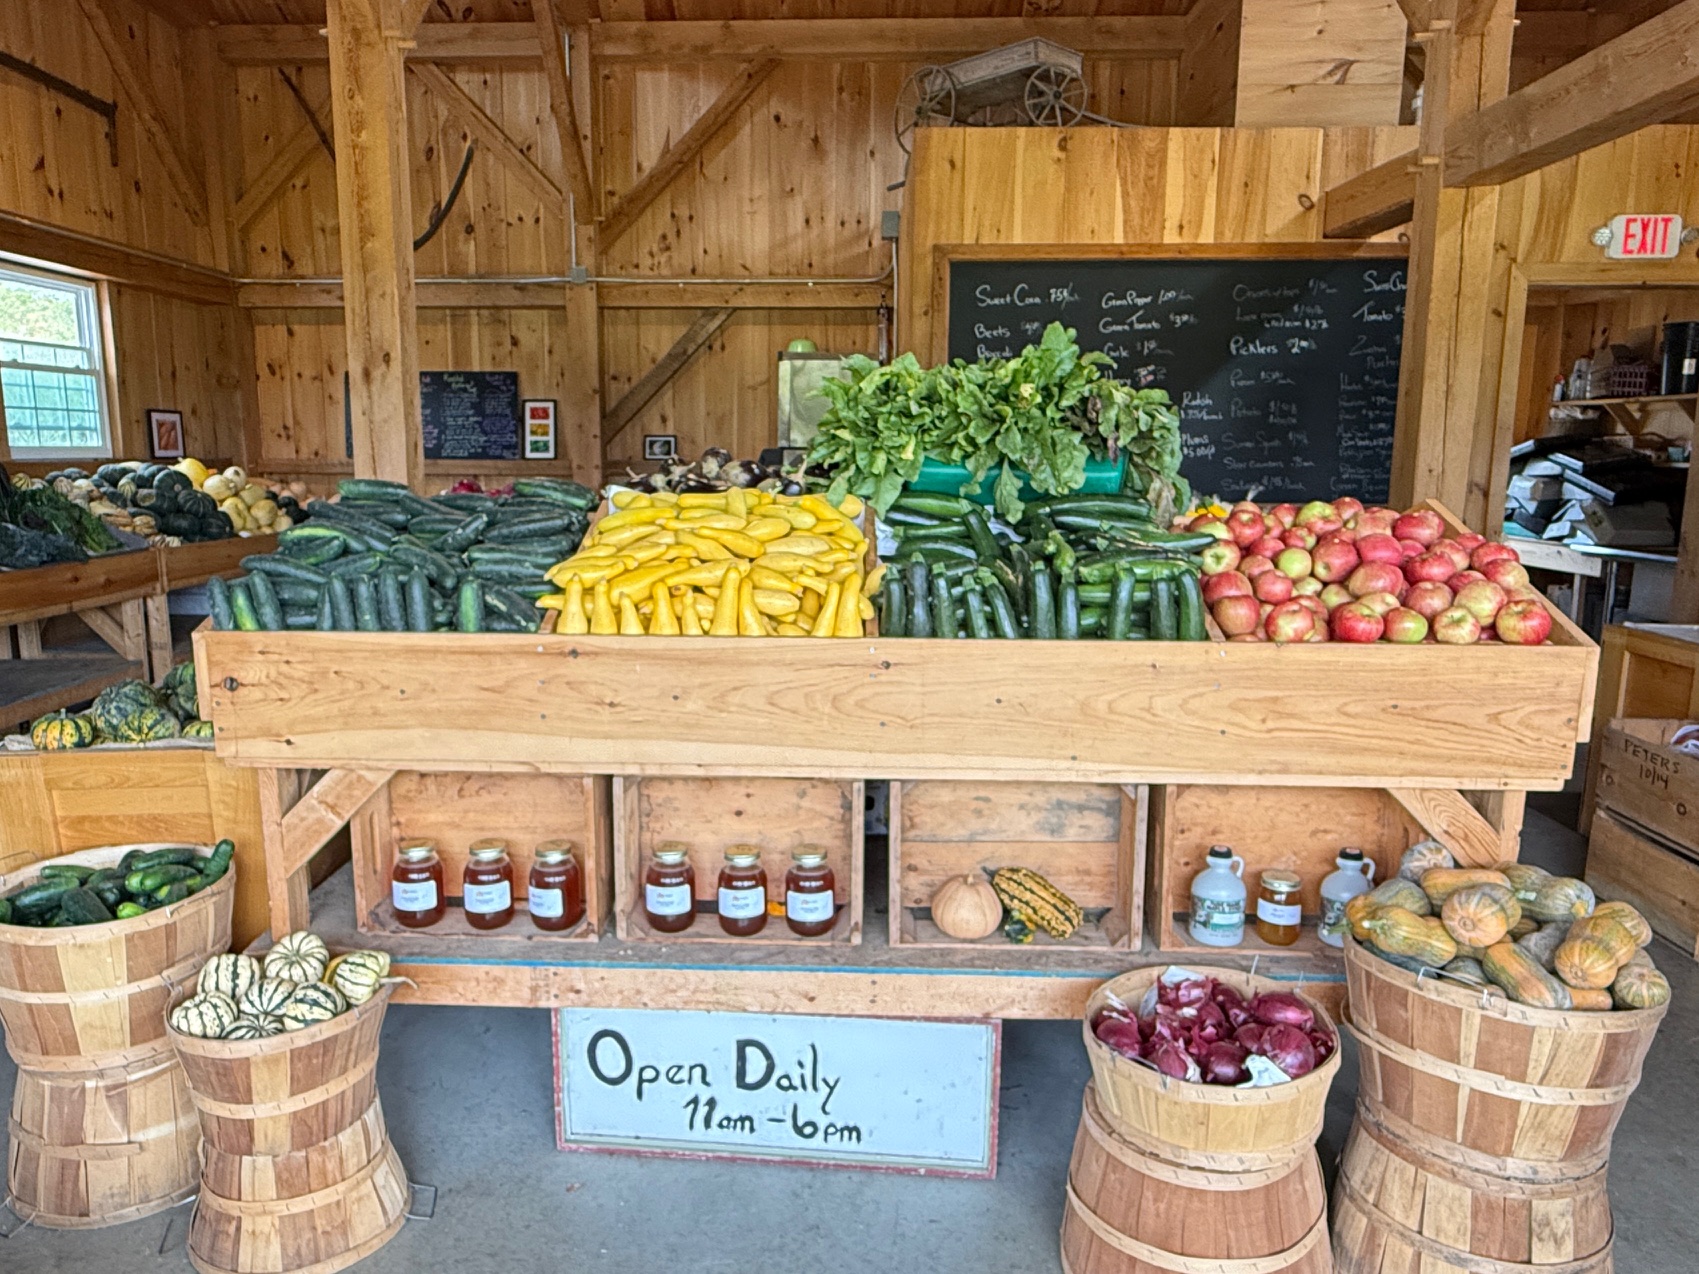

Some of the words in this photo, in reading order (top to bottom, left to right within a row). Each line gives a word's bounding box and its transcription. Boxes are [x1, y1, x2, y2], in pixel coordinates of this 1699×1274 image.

[1622, 216, 1674, 255] EXIT
[974, 323, 1011, 339] Beets
[1624, 738, 1680, 774] PETERS
[586, 1028, 712, 1101] Open
[735, 1038, 841, 1115] Daily
[682, 1094, 756, 1134] 11am
